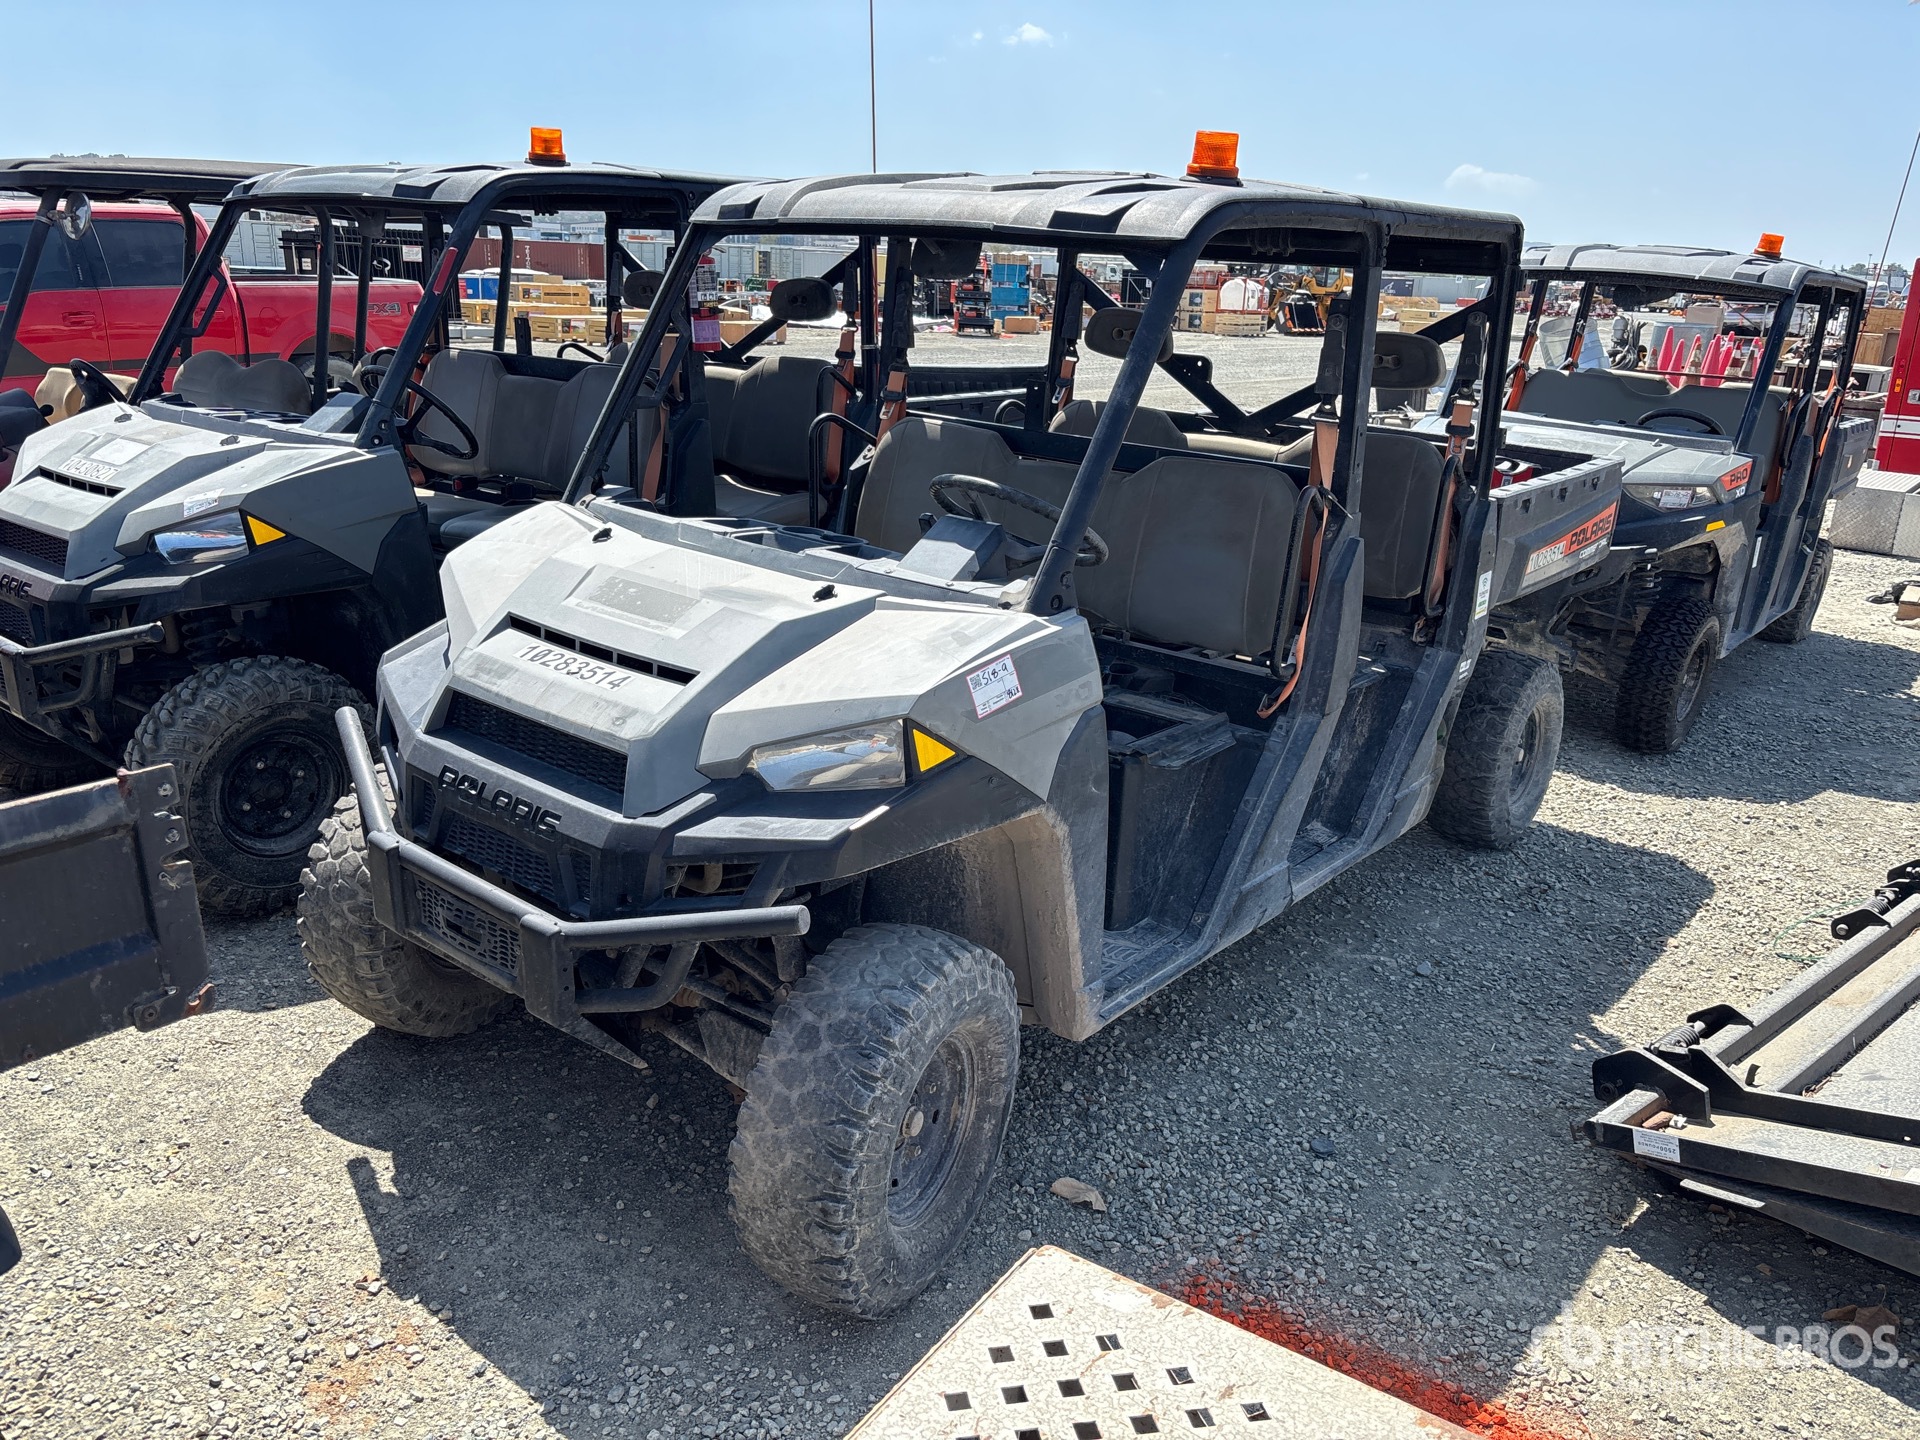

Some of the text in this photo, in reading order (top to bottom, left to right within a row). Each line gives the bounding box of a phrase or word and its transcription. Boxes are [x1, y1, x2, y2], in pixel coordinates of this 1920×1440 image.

[62, 459, 119, 482] 10430827
[1729, 468, 1748, 486] PRO
[1735, 486, 1746, 499] XD
[1568, 512, 1613, 551] POLARIS
[0, 573, 33, 598] ARIS
[520, 645, 632, 690] 10283514
[438, 764, 563, 840] POLARIS
